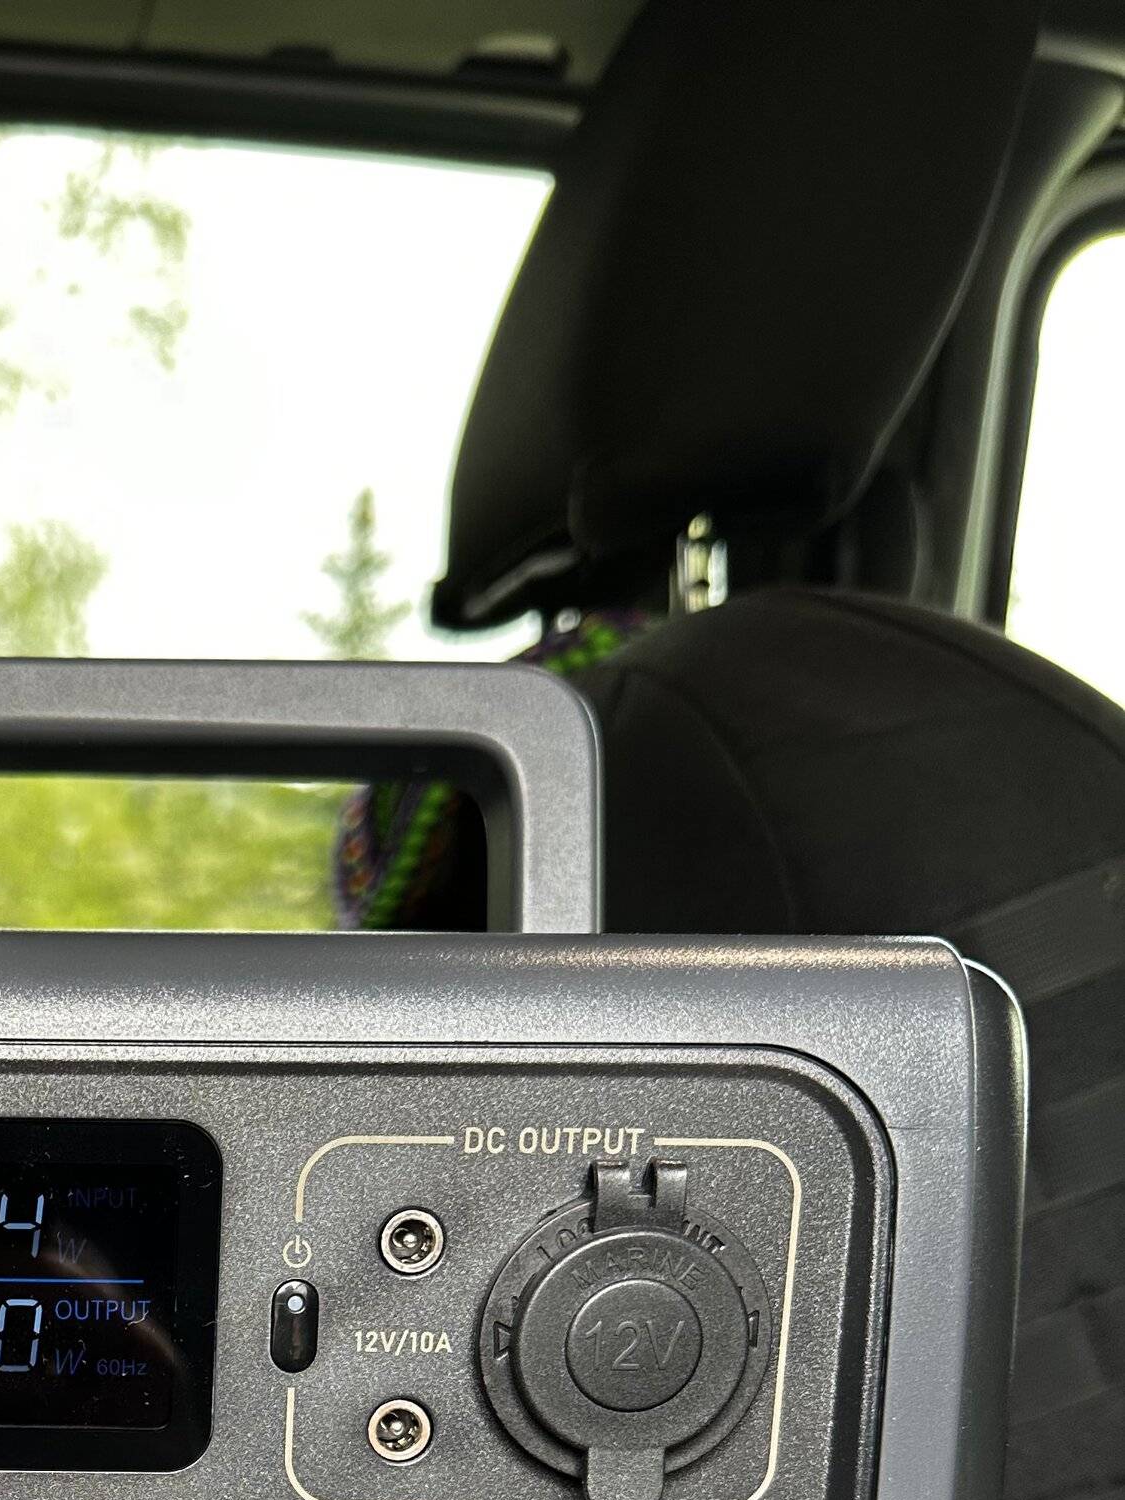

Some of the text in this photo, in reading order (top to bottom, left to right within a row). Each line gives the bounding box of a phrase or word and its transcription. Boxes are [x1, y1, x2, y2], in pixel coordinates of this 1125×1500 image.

[463, 1128, 645, 1155] DC OUTPUT
[571, 1246, 707, 1292] MARINE
[54, 1300, 152, 1321] OUTPUT
[354, 1330, 454, 1355] 12V/10A
[584, 1321, 687, 1375] 12V
[96, 1358, 148, 1377] 60Hz
